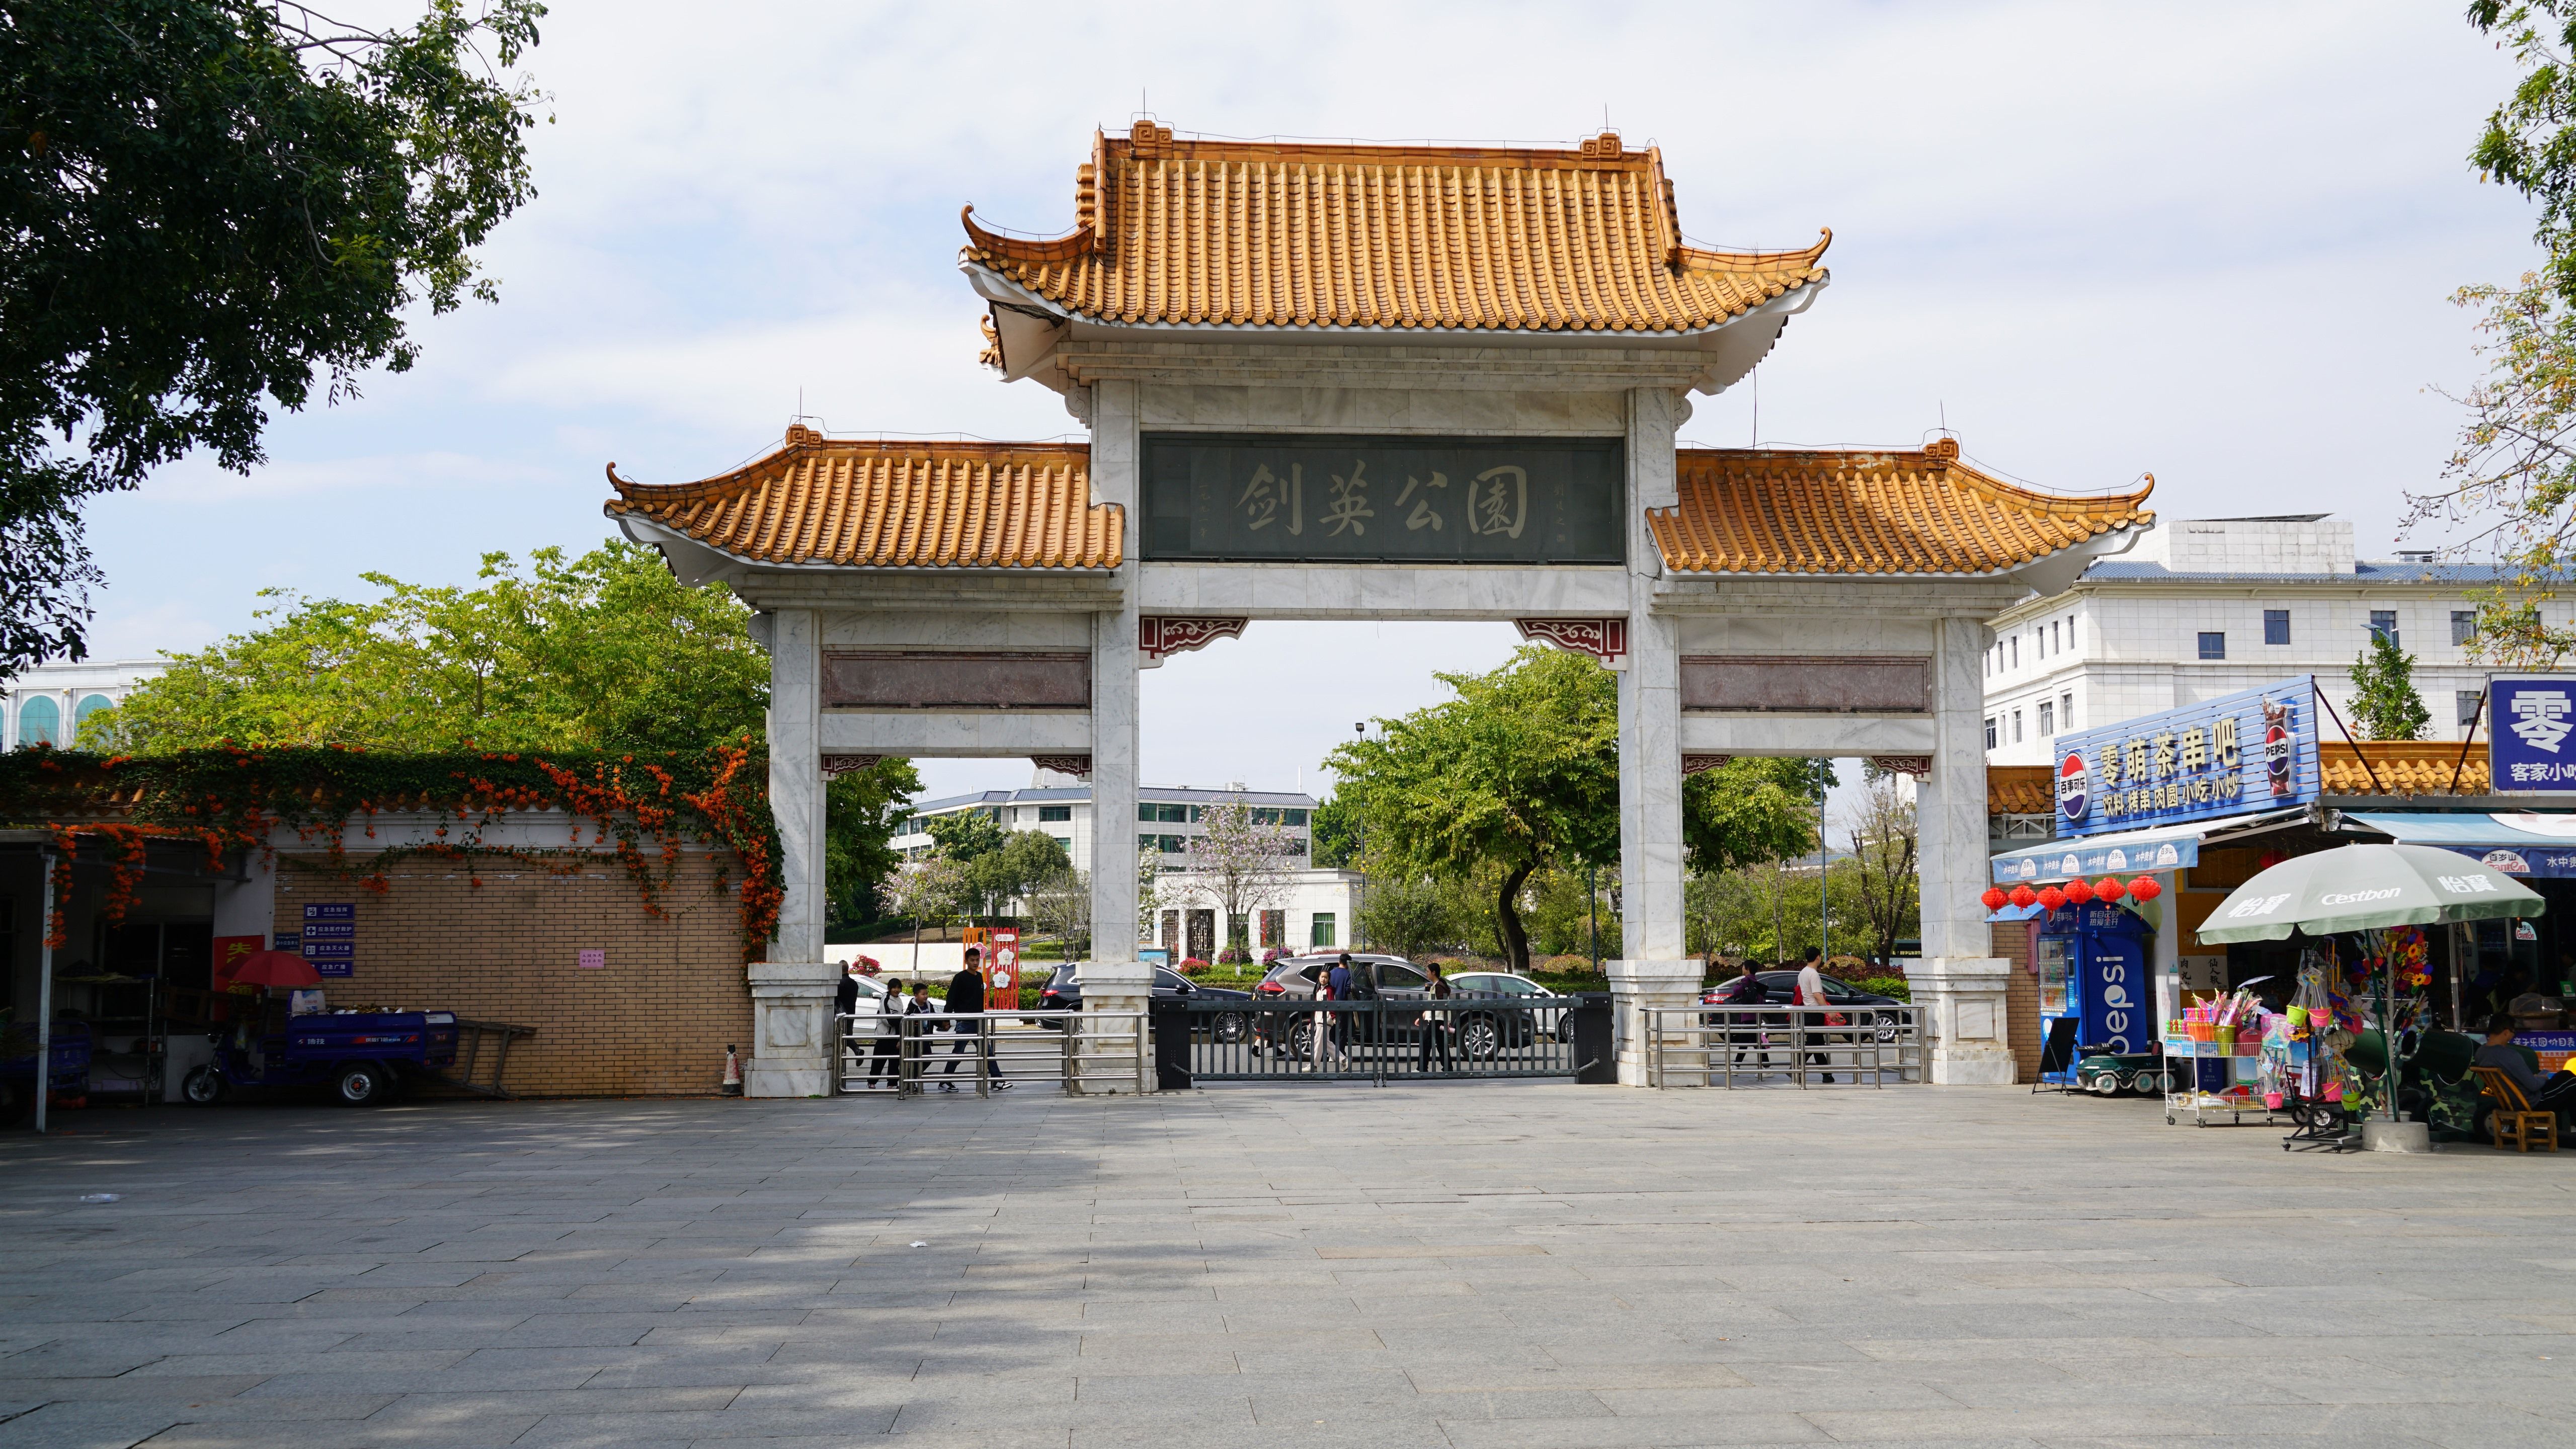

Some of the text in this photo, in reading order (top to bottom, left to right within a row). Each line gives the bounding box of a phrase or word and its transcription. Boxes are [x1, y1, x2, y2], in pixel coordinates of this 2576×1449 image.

[2100, 716, 2239, 788] 零萌茶串吧
[2266, 743, 2289, 757] PEPSI
[2060, 776, 2086, 794] 百事可乐
[2103, 771, 2237, 817] 饮料 烤串 肉圆 小吃 小炒
[2087, 856, 2106, 866] 水中贵族
[2135, 851, 2154, 862] 水中贵族
[2489, 853, 2517, 861] 百岁山
[2003, 864, 2019, 874] 水中贵族
[2043, 860, 2060, 870] 水中贵族
[2056, 912, 2073, 922] 百事可乐
[2089, 910, 2118, 918] 听自己的
[2089, 918, 2118, 926] 热爱全开
[226, 942, 254, 996] 失领
[2180, 958, 2191, 980] 肉丸
[2513, 1036, 2575, 1048] 亲子乐园价目表
